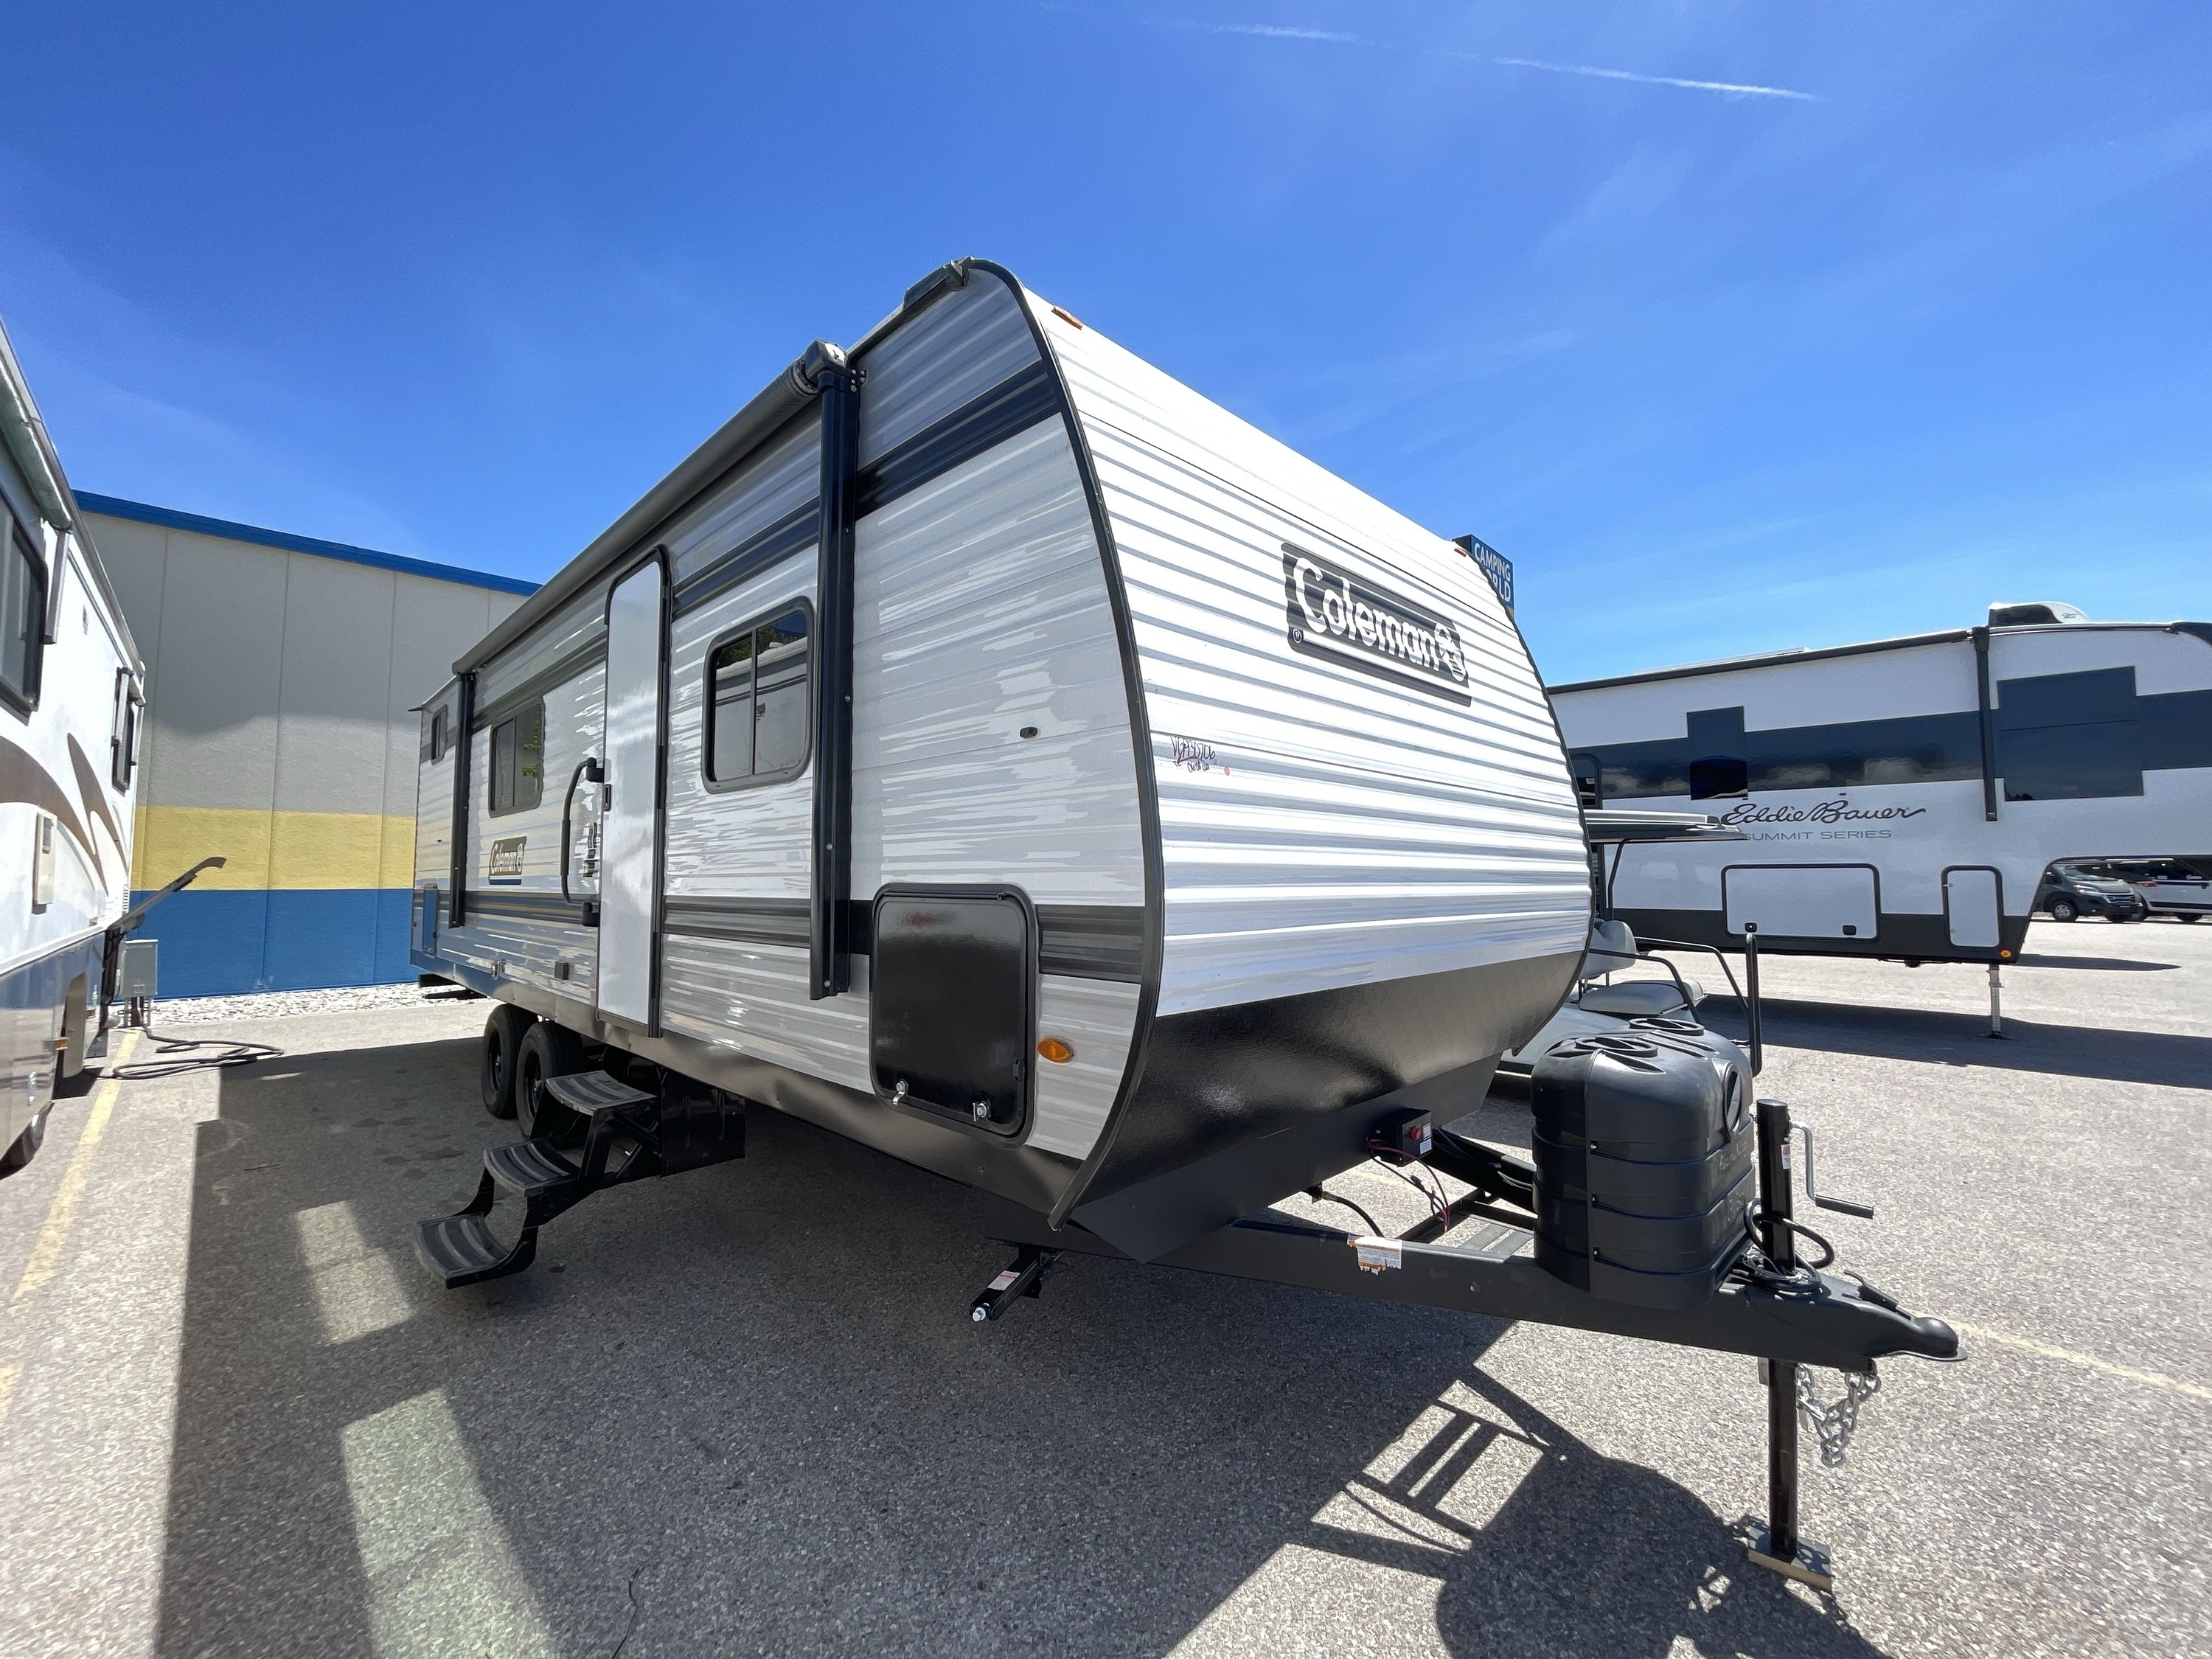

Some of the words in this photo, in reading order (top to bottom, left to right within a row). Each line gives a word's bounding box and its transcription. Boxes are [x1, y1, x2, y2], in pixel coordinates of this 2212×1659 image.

[1475, 543, 1511, 582] CAMPING
[1293, 557, 1440, 672] Coleman
[1721, 804, 1809, 824] Eddie
[1809, 800, 1926, 824] Bauer
[1745, 832, 1814, 841] SUMMIT
[1820, 830, 1892, 840] SERIES
